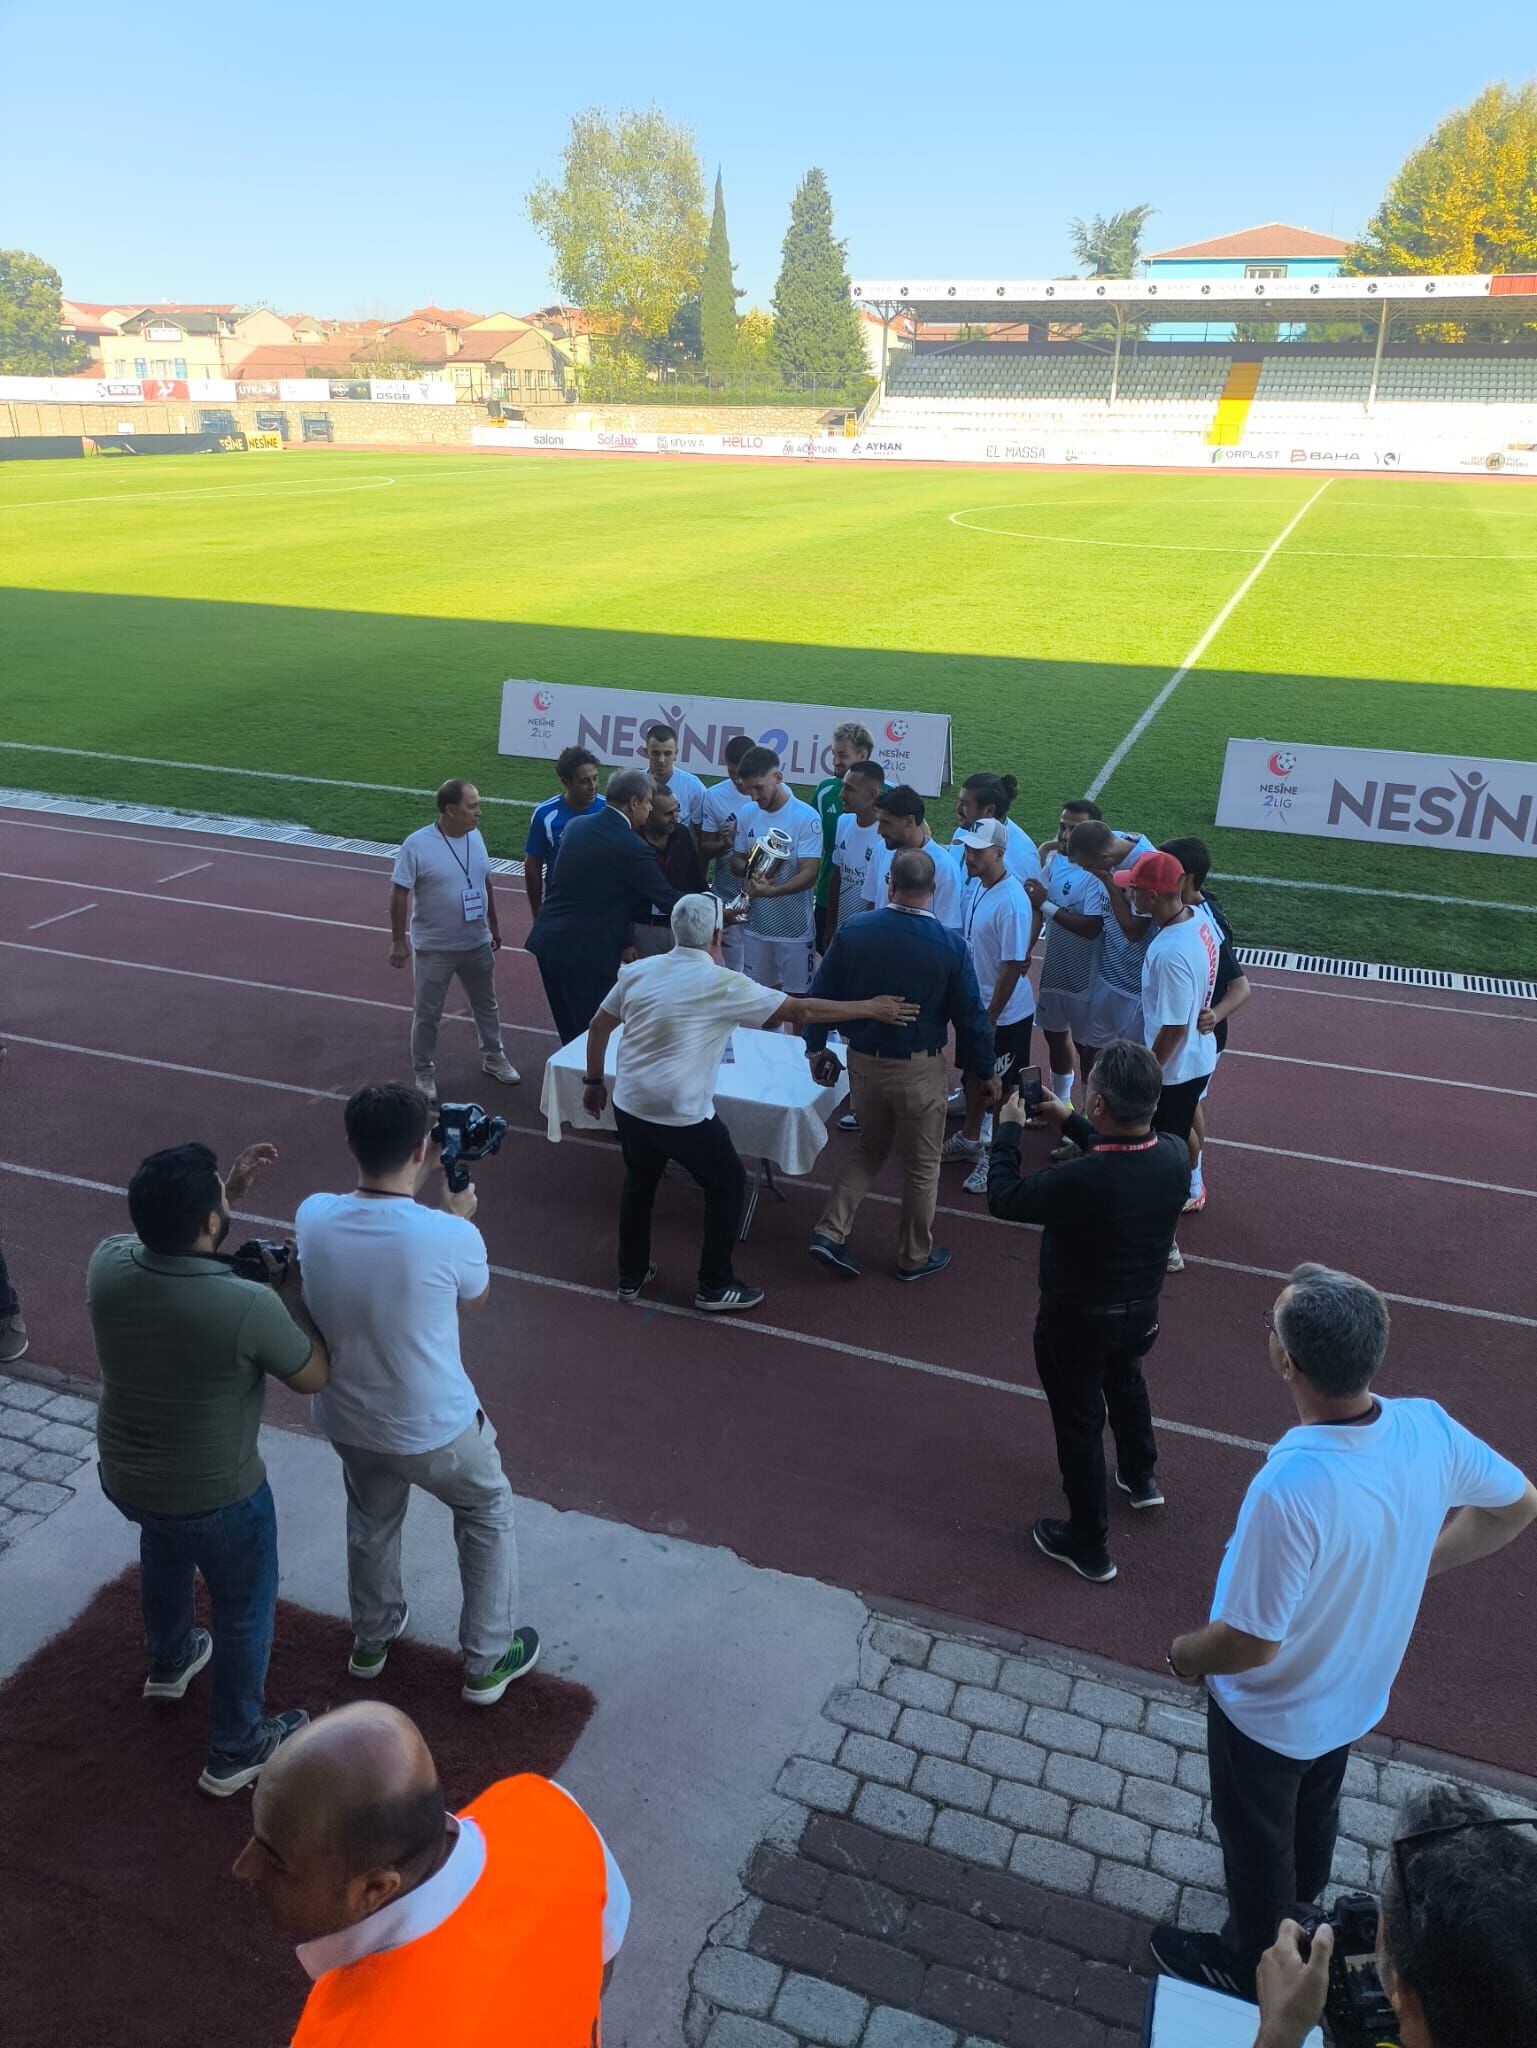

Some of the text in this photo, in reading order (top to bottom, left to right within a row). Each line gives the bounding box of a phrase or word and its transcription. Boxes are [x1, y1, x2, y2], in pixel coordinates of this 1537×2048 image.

[533, 434, 564, 445] saloni
[597, 433, 638, 446] Sofalux
[866, 442, 902, 451] AYHAN
[986, 445, 1046, 459] EL MASSA
[1310, 451, 1360, 460] BAHA
[1327, 767, 1537, 846] NESİN
